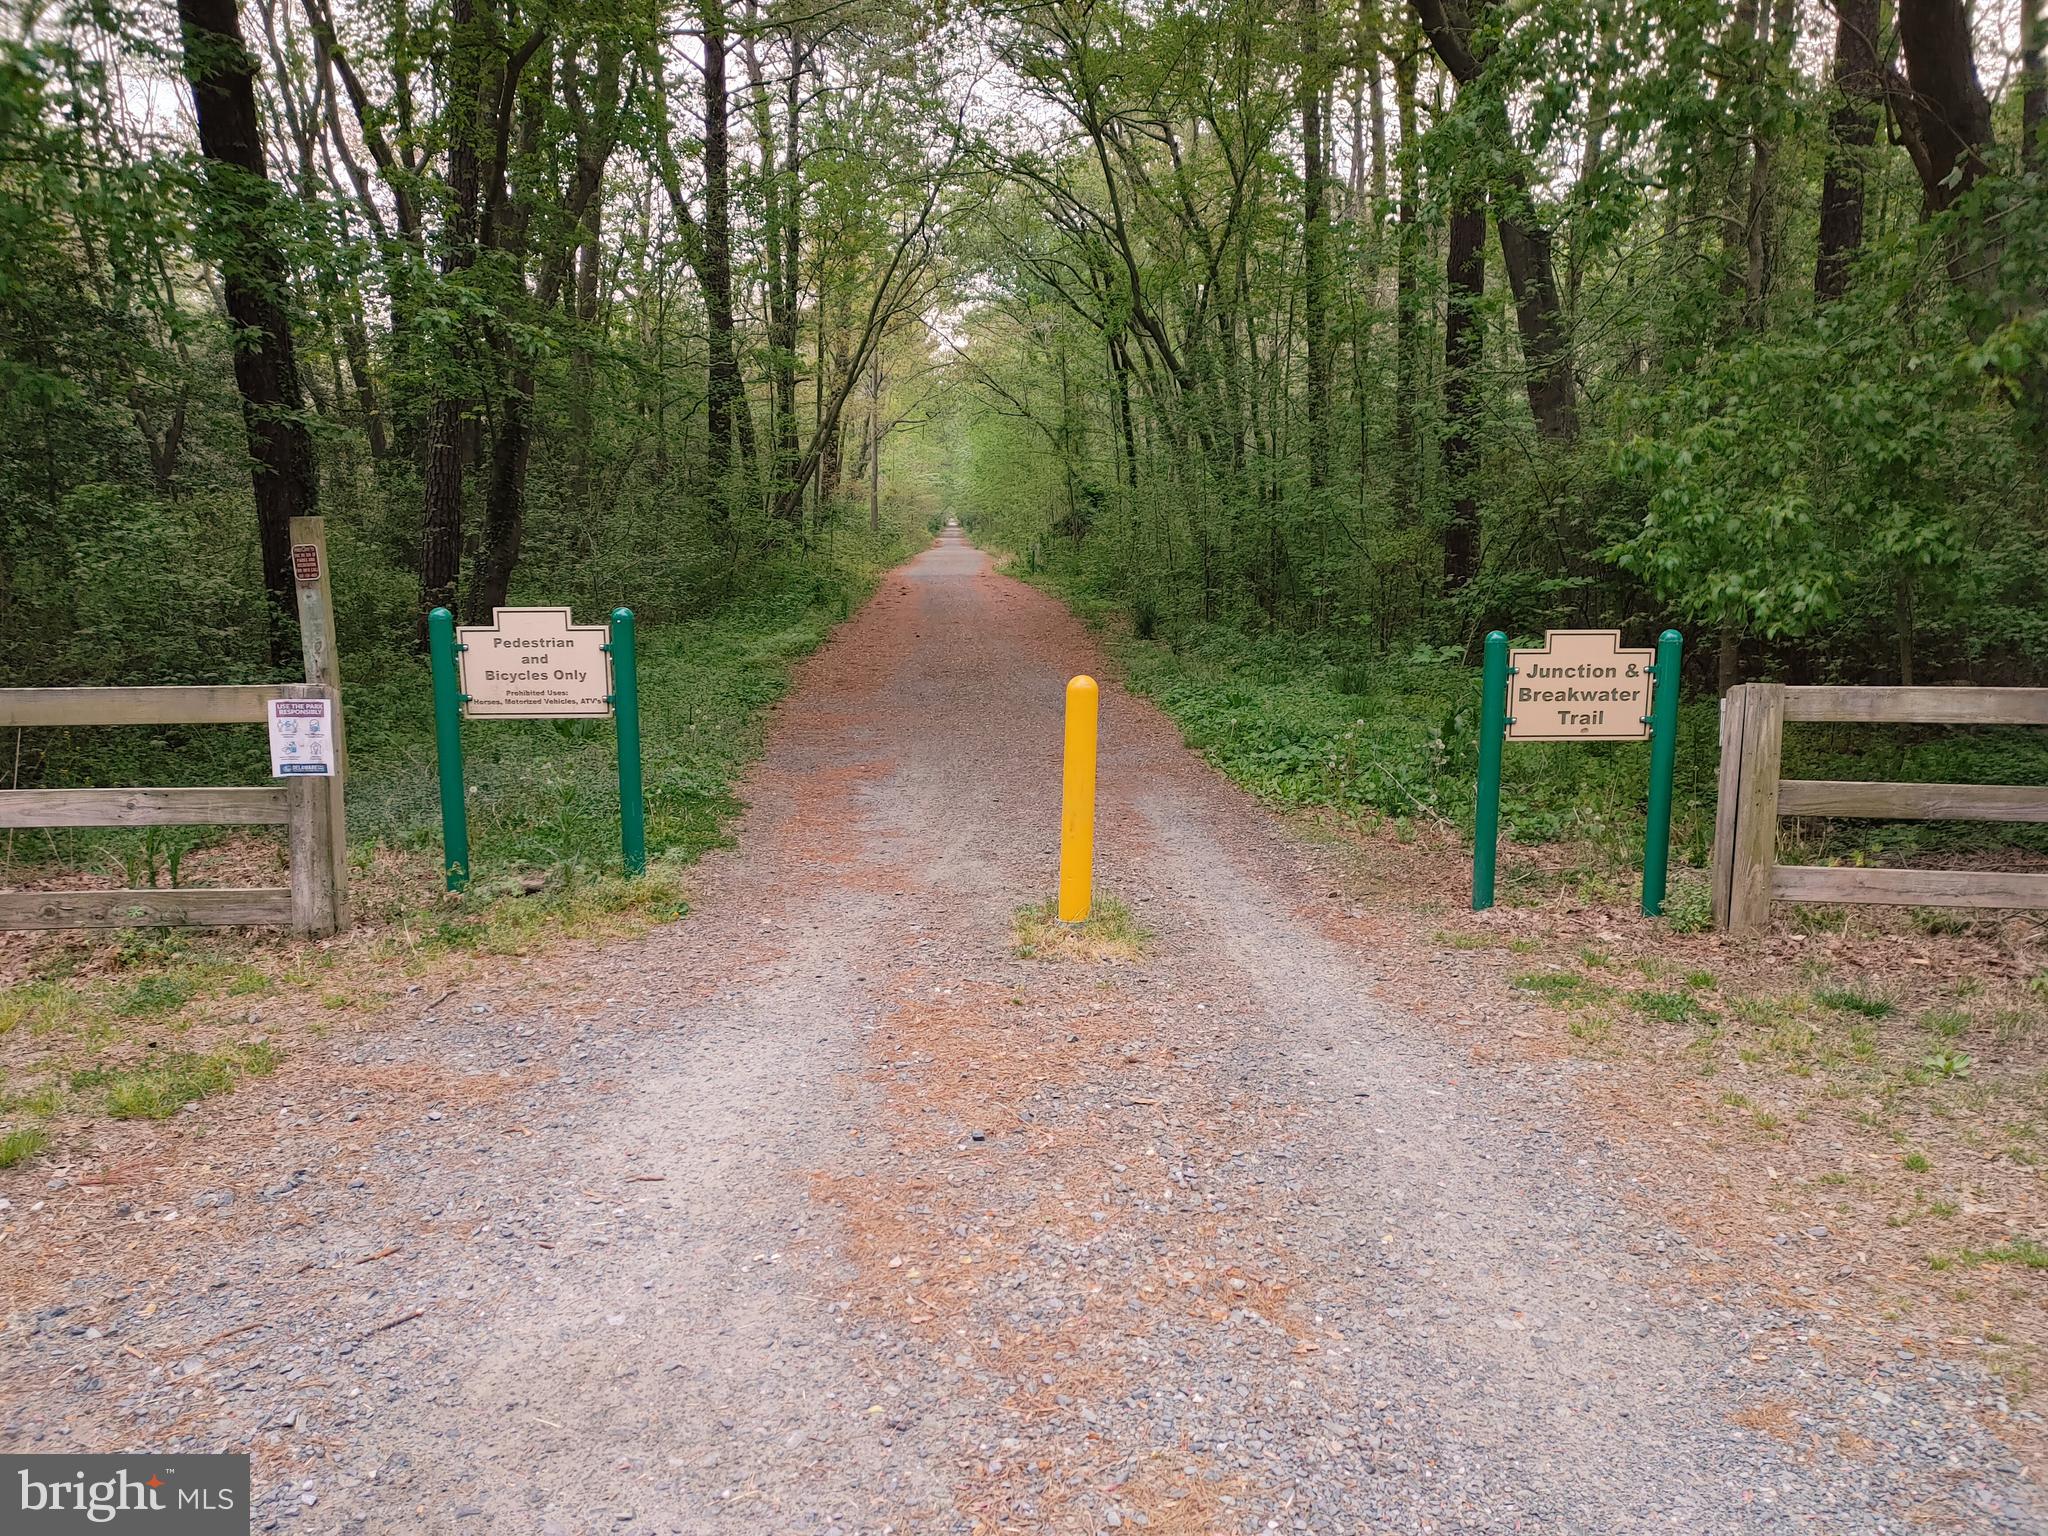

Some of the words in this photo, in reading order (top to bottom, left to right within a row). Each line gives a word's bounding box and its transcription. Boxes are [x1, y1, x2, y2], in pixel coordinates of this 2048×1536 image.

[493, 637, 574, 648] Pedestrian
[521, 654, 549, 664] and
[485, 670, 549, 683] Bicycles
[553, 670, 587, 682] Only
[1526, 663, 1617, 679] Junction
[1625, 663, 1640, 678] &
[1518, 687, 1641, 702] Breakwater
[1557, 710, 1604, 725] Trail
